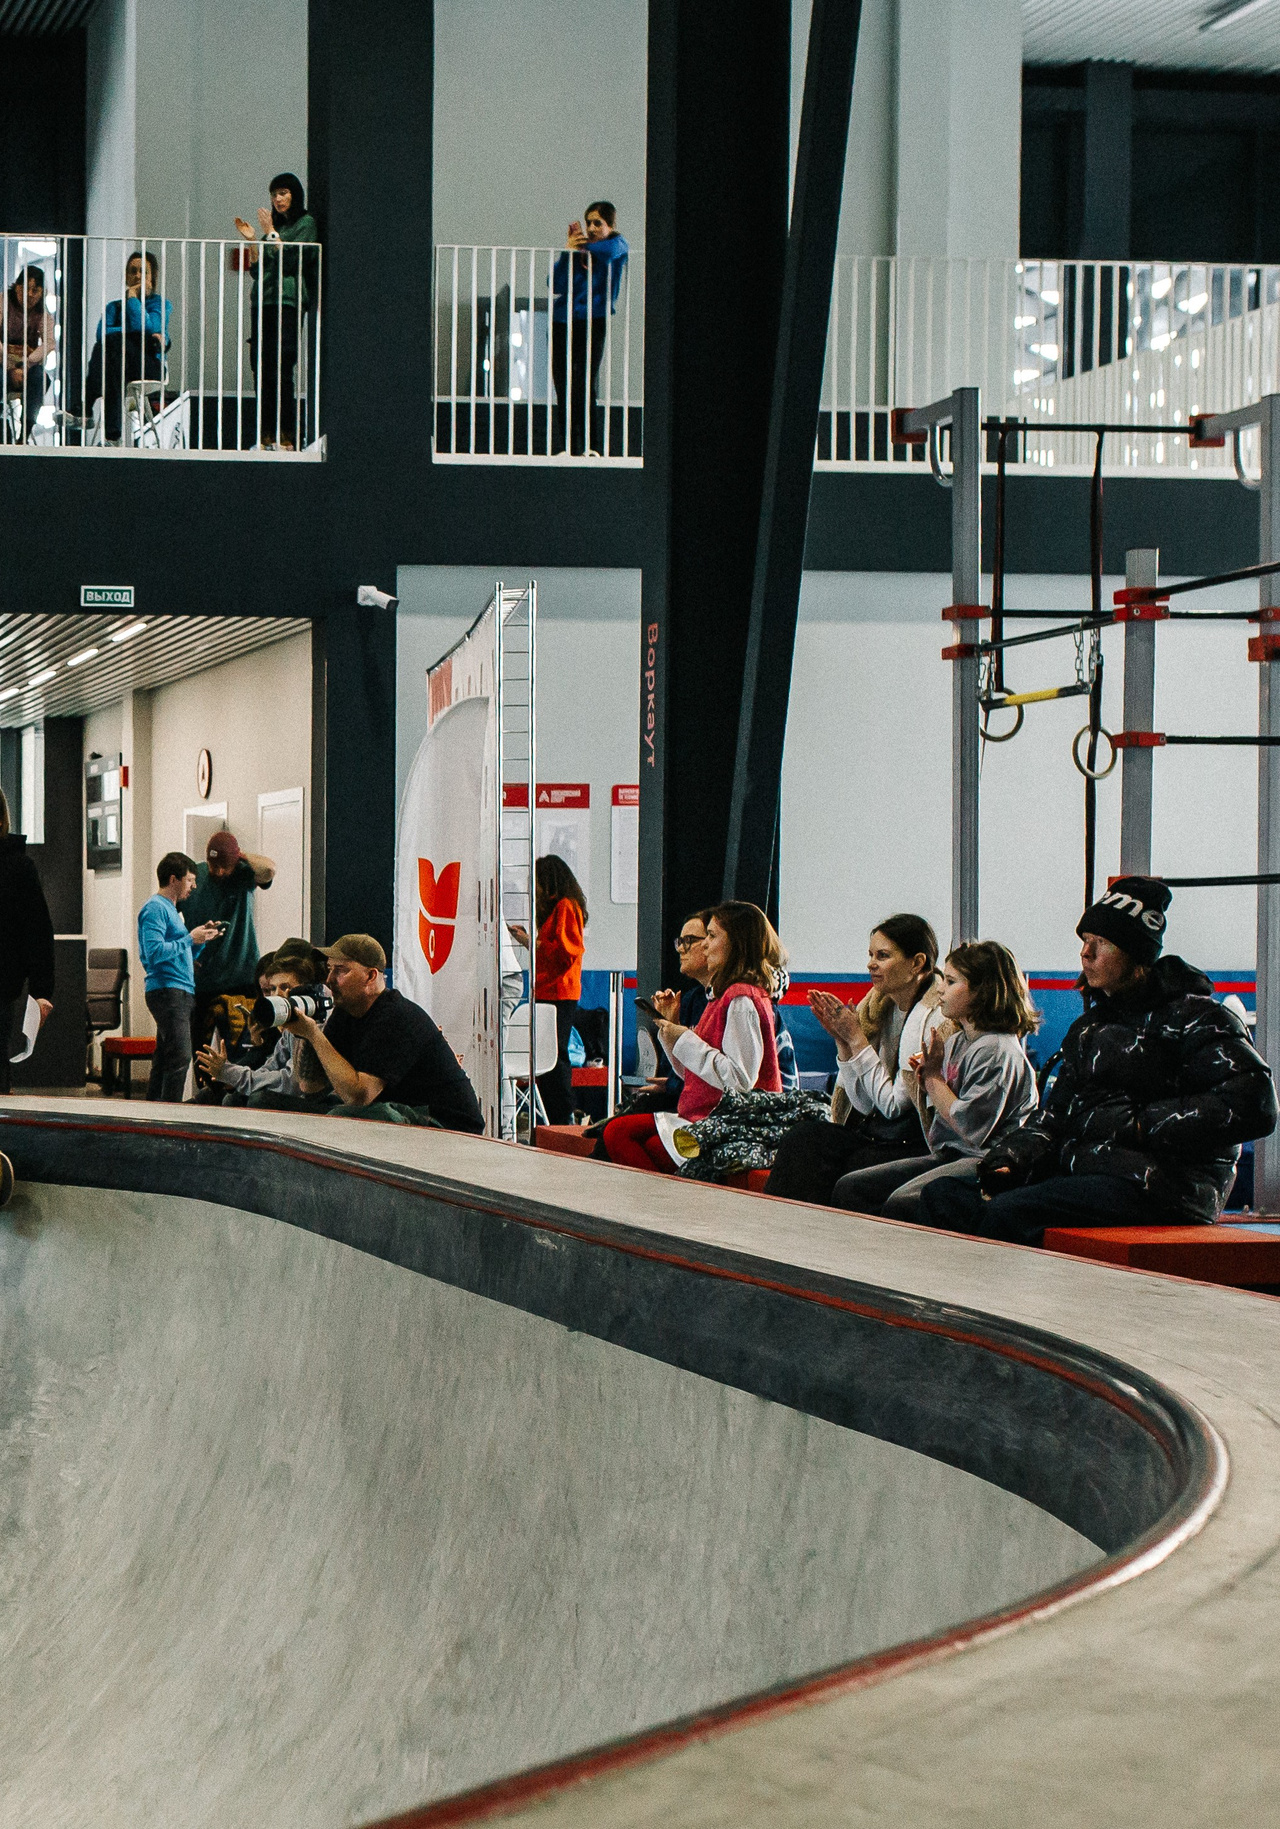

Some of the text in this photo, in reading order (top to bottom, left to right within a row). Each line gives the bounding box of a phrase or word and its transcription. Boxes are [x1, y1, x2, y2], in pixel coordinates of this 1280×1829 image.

[86, 591, 130, 603] ВЫХОД
[644, 622, 658, 767] Воркаут
[1101, 891, 1164, 931] me
